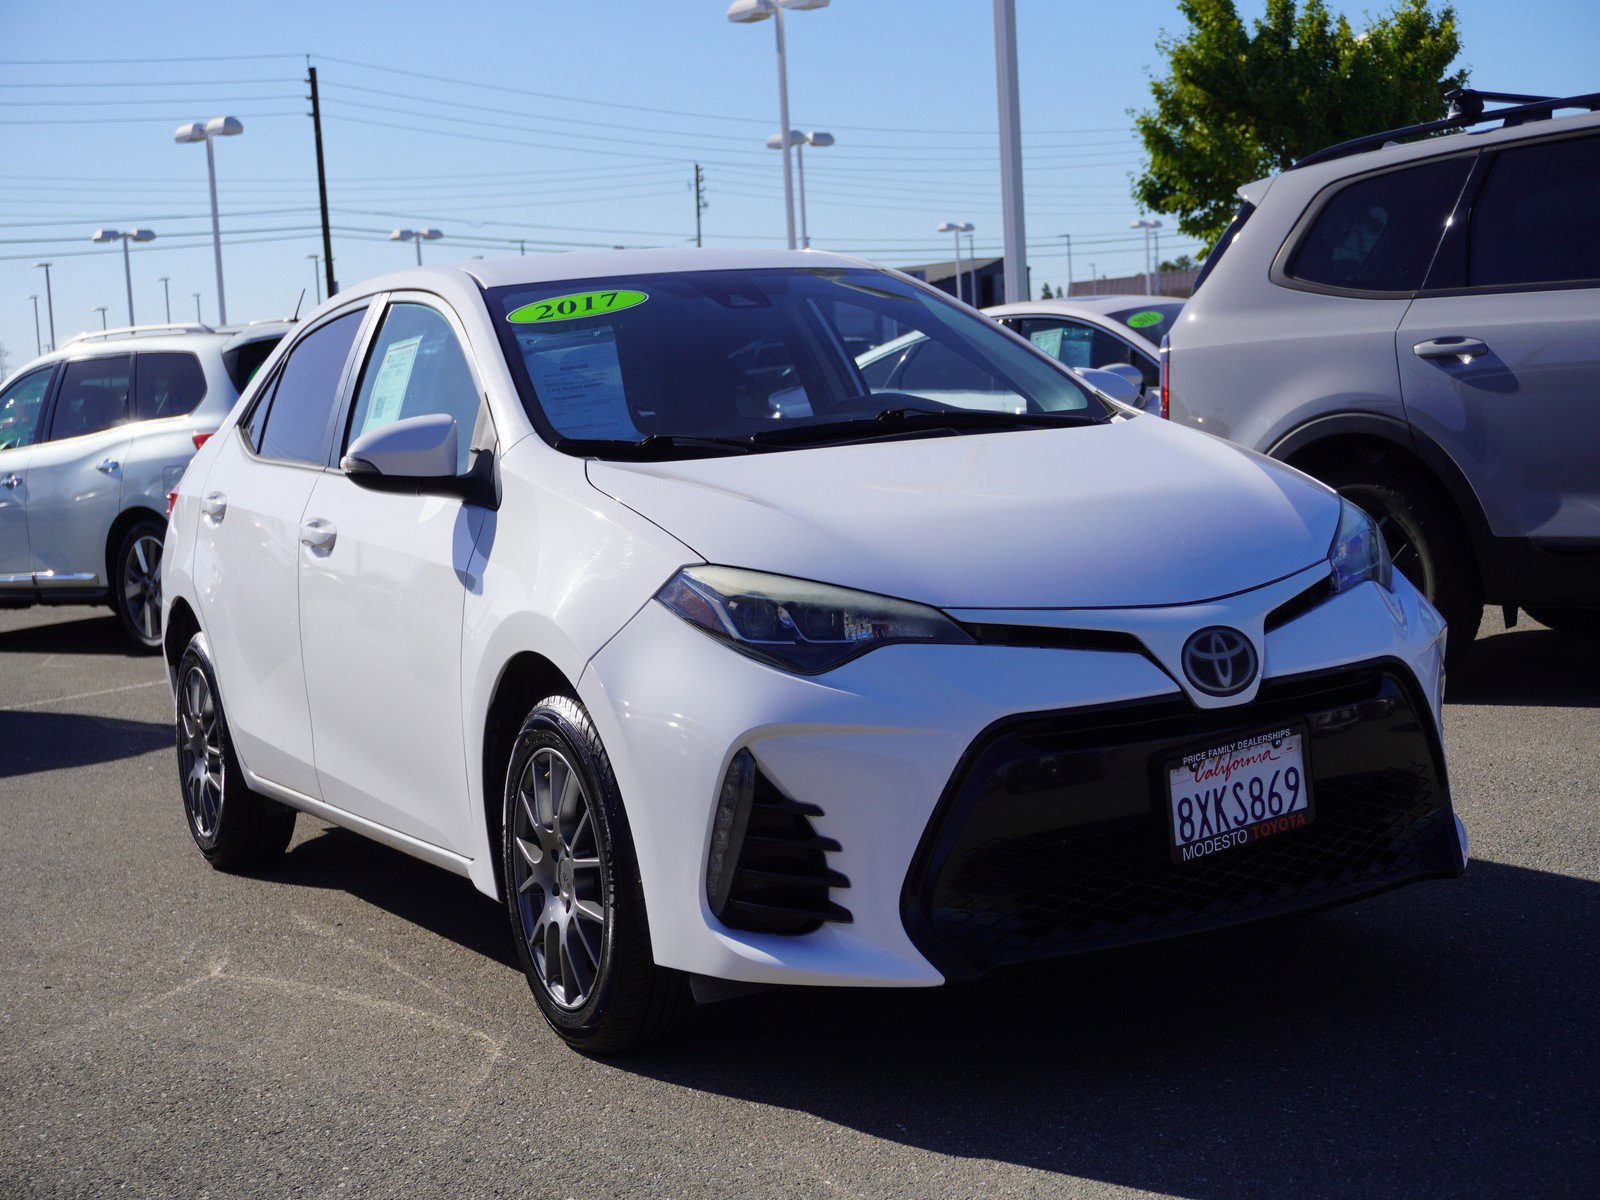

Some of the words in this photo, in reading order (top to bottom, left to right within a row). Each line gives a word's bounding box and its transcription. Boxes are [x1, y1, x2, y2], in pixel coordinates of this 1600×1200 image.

[535, 292, 619, 321] 2017
[1182, 751, 1206, 766] PRICE
[1208, 743, 1237, 758] FAMILY
[1237, 728, 1291, 750] DEALERSHIPS
[1194, 749, 1281, 783] California
[1177, 766, 1300, 843] 8XKS869
[1182, 829, 1248, 862] MODESTO
[1251, 814, 1306, 840] TOYOTA
